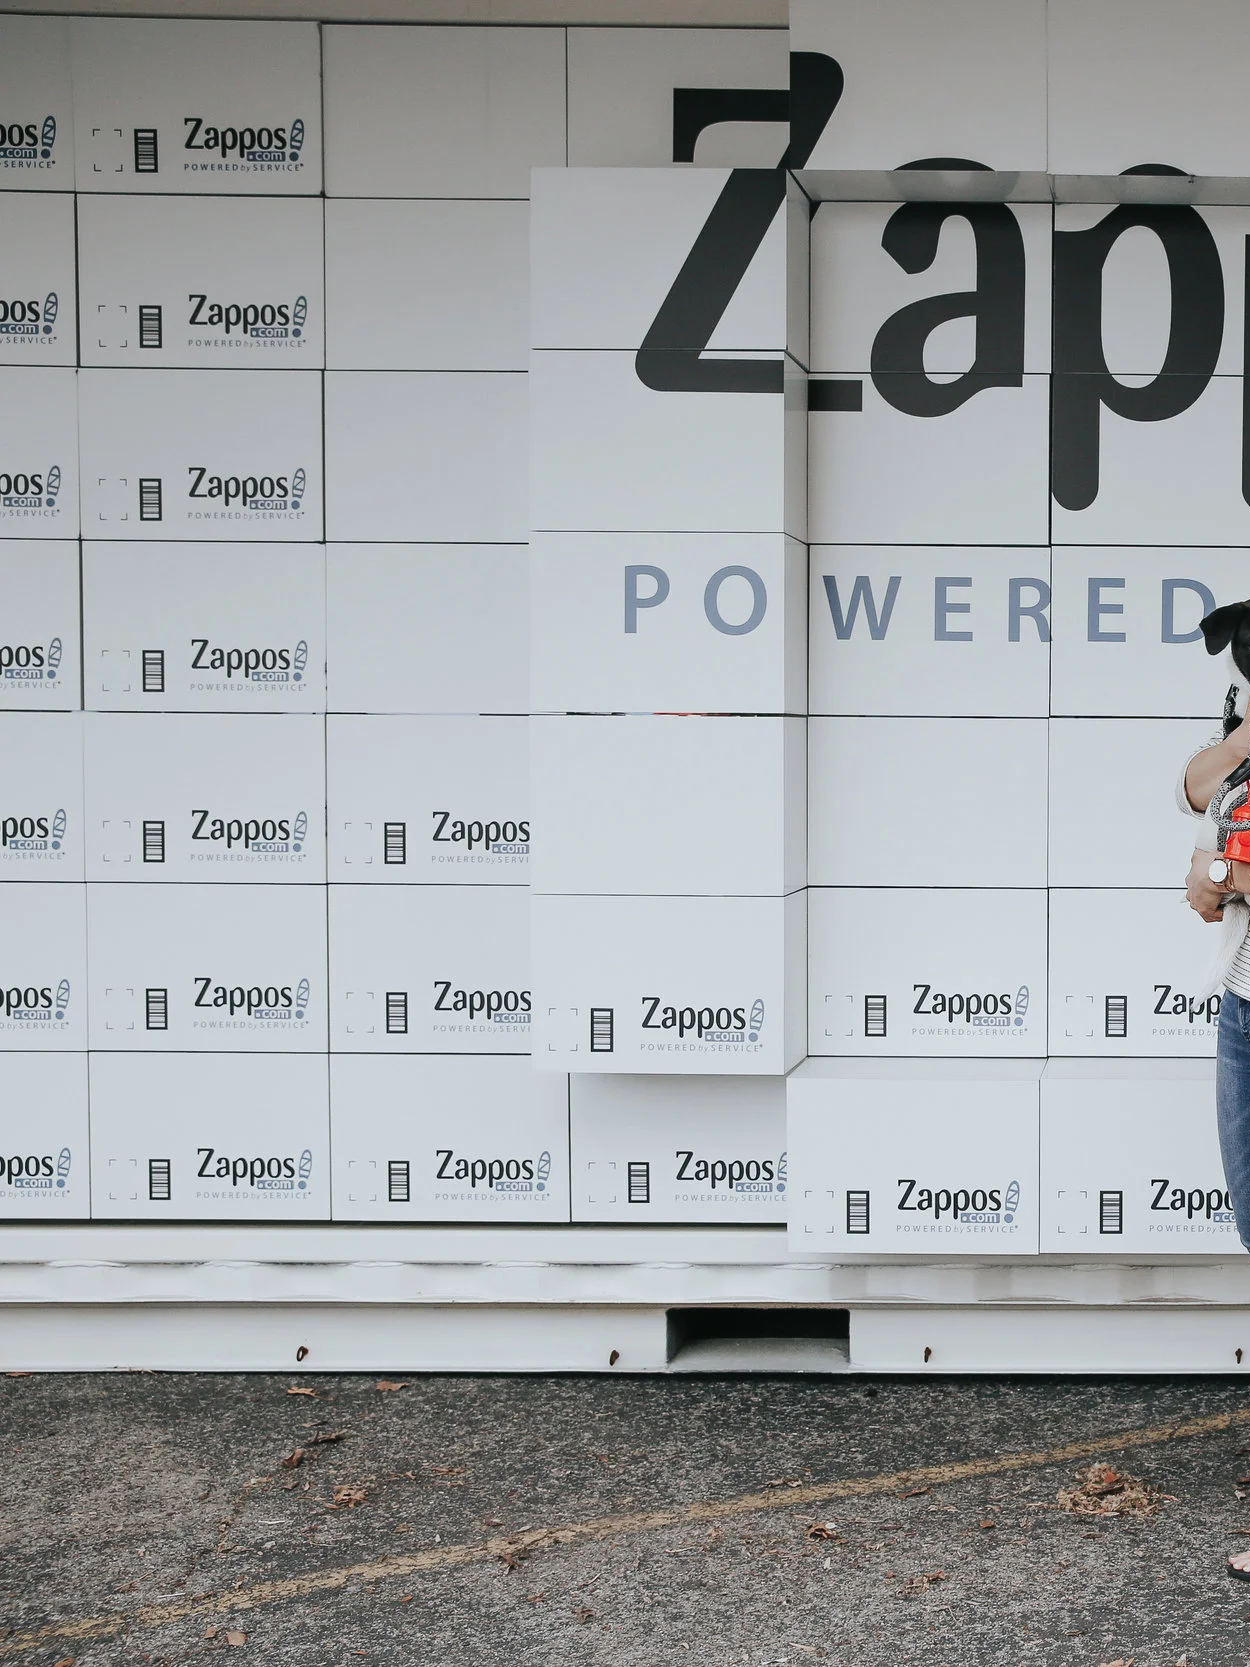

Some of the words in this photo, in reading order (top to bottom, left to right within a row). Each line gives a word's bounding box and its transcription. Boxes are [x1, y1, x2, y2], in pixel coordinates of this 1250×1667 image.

[184, 118, 286, 159] Zappos
[188, 294, 290, 336] Zappos
[188, 468, 288, 508] Zappos
[623, 565, 1217, 646] POWERED
[192, 640, 290, 680] Zappos
[192, 810, 290, 849] Zappos
[432, 812, 530, 851] Zappos
[194, 978, 292, 1017] Zappos
[434, 982, 532, 1021] Zappos
[642, 996, 746, 1039] Zappos
[914, 984, 1012, 1024] Zappos
[1154, 984, 1222, 1024] Zapp
[1152, 1028, 1205, 1036] POWERED
[198, 1148, 296, 1188] Zappos
[436, 1150, 534, 1189] Zappos
[676, 1152, 774, 1191] Zappos
[898, 1180, 1002, 1222] Zappos
[1151, 1178, 1234, 1220] Zapp
[1149, 1224, 1205, 1233] POWERED
